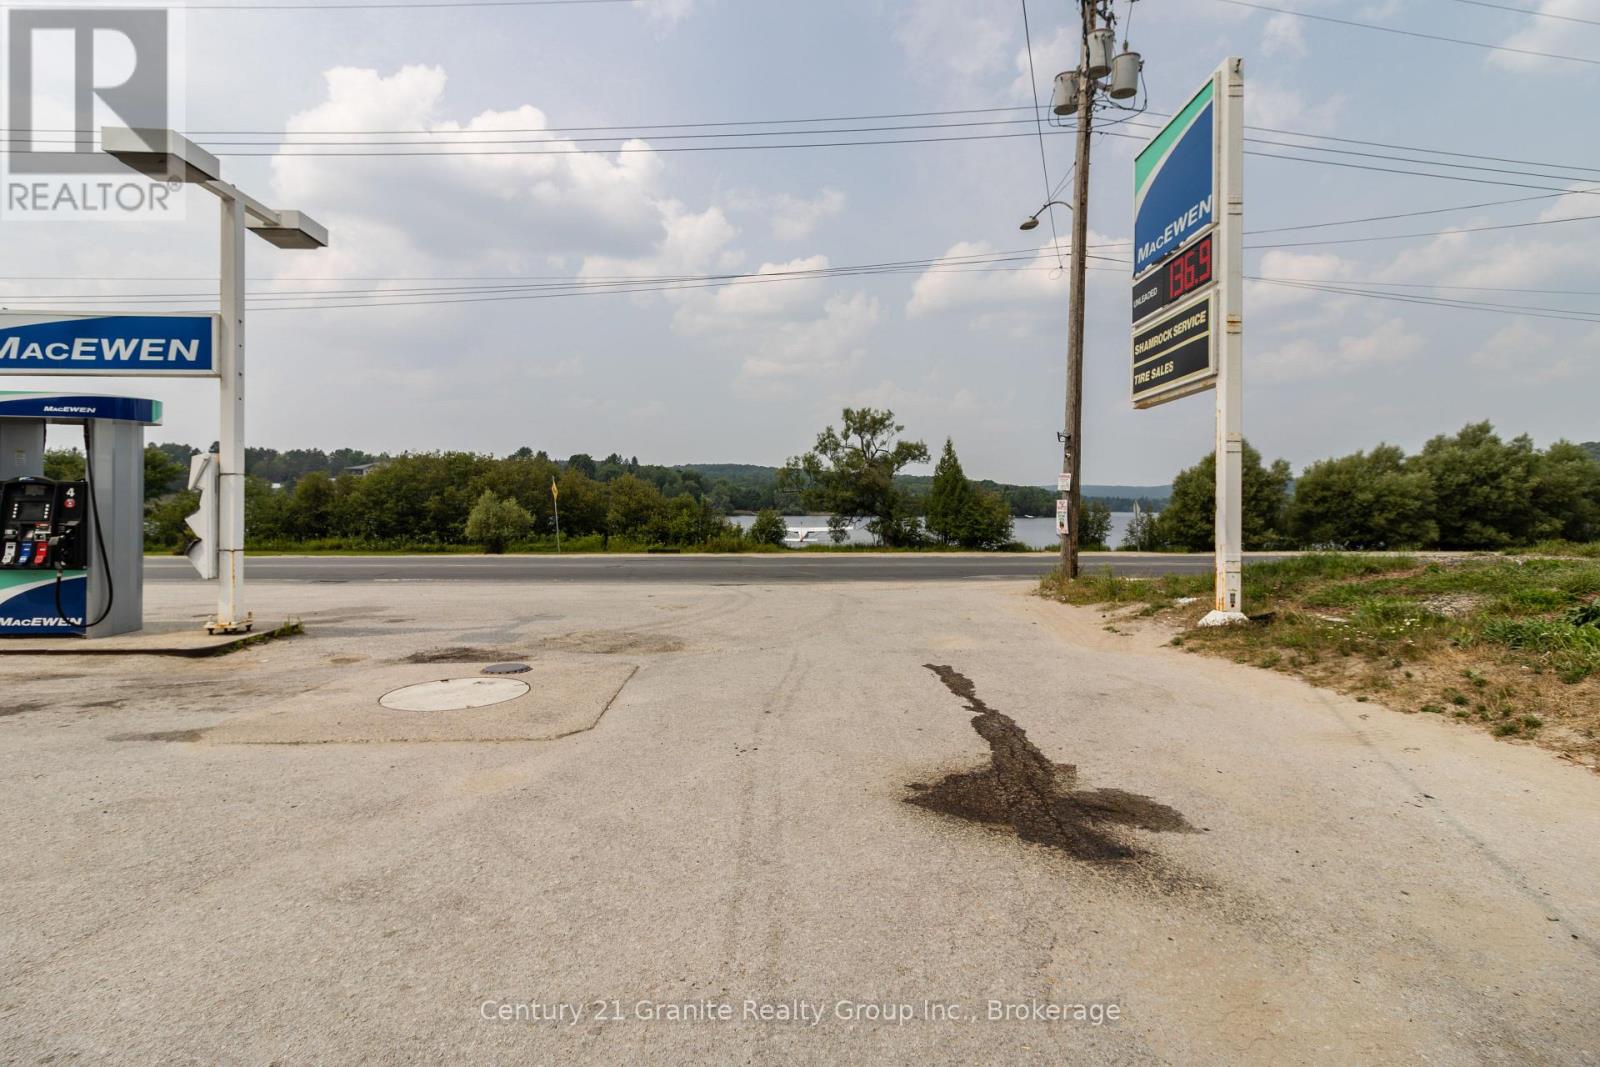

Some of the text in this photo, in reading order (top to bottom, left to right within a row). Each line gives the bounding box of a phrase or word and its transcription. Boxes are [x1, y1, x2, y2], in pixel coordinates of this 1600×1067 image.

[1133, 287, 1158, 308] UNLEADED
[1134, 310, 1207, 356] SHAMROCK SERVICE
[1134, 361, 1174, 386] TIRE SALES
[66, 487, 75, 497] 4
